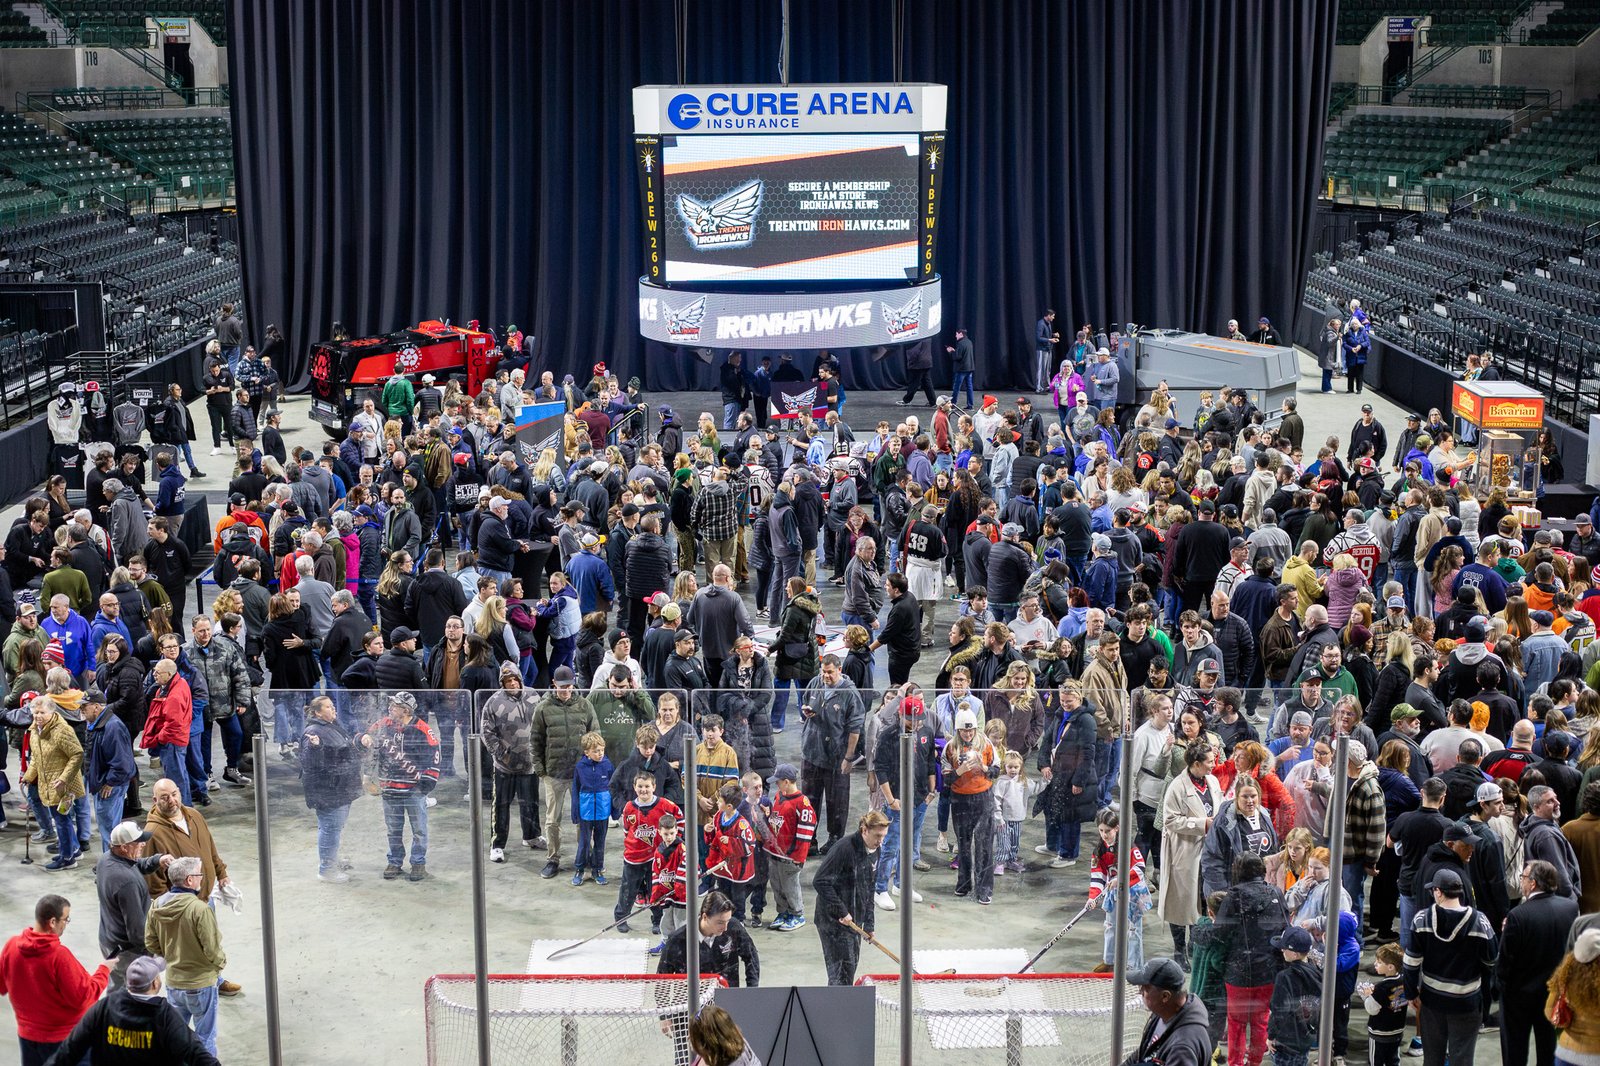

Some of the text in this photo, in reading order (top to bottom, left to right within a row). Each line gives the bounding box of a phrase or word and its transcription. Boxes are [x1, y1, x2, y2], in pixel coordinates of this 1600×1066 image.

[84, 51, 99, 67] 118
[1478, 49, 1493, 65] 103
[706, 91, 914, 116] CURE ARENA
[707, 118, 799, 129] INSURANCE
[788, 181, 891, 192] SECURE A MEMBERSHIP
[812, 191, 867, 200] TEAM STORE
[800, 200, 879, 210] IRONHAWKS NEWS
[718, 224, 750, 234] TRENTON
[768, 219, 910, 232] TRENTONIRONHAWKS.COM
[698, 232, 750, 245] IRONHAWKS
[715, 301, 873, 340] IRONHAWKS
[471, 347, 483, 388] MCIA
[1490, 405, 1535, 416] Bavarian
[454, 488, 479, 498] CLUB
[908, 532, 929, 552] 38
[1351, 547, 1376, 556] BERTOLI
[801, 808, 814, 823] 86
[107, 1025, 153, 1049] SECURITY
